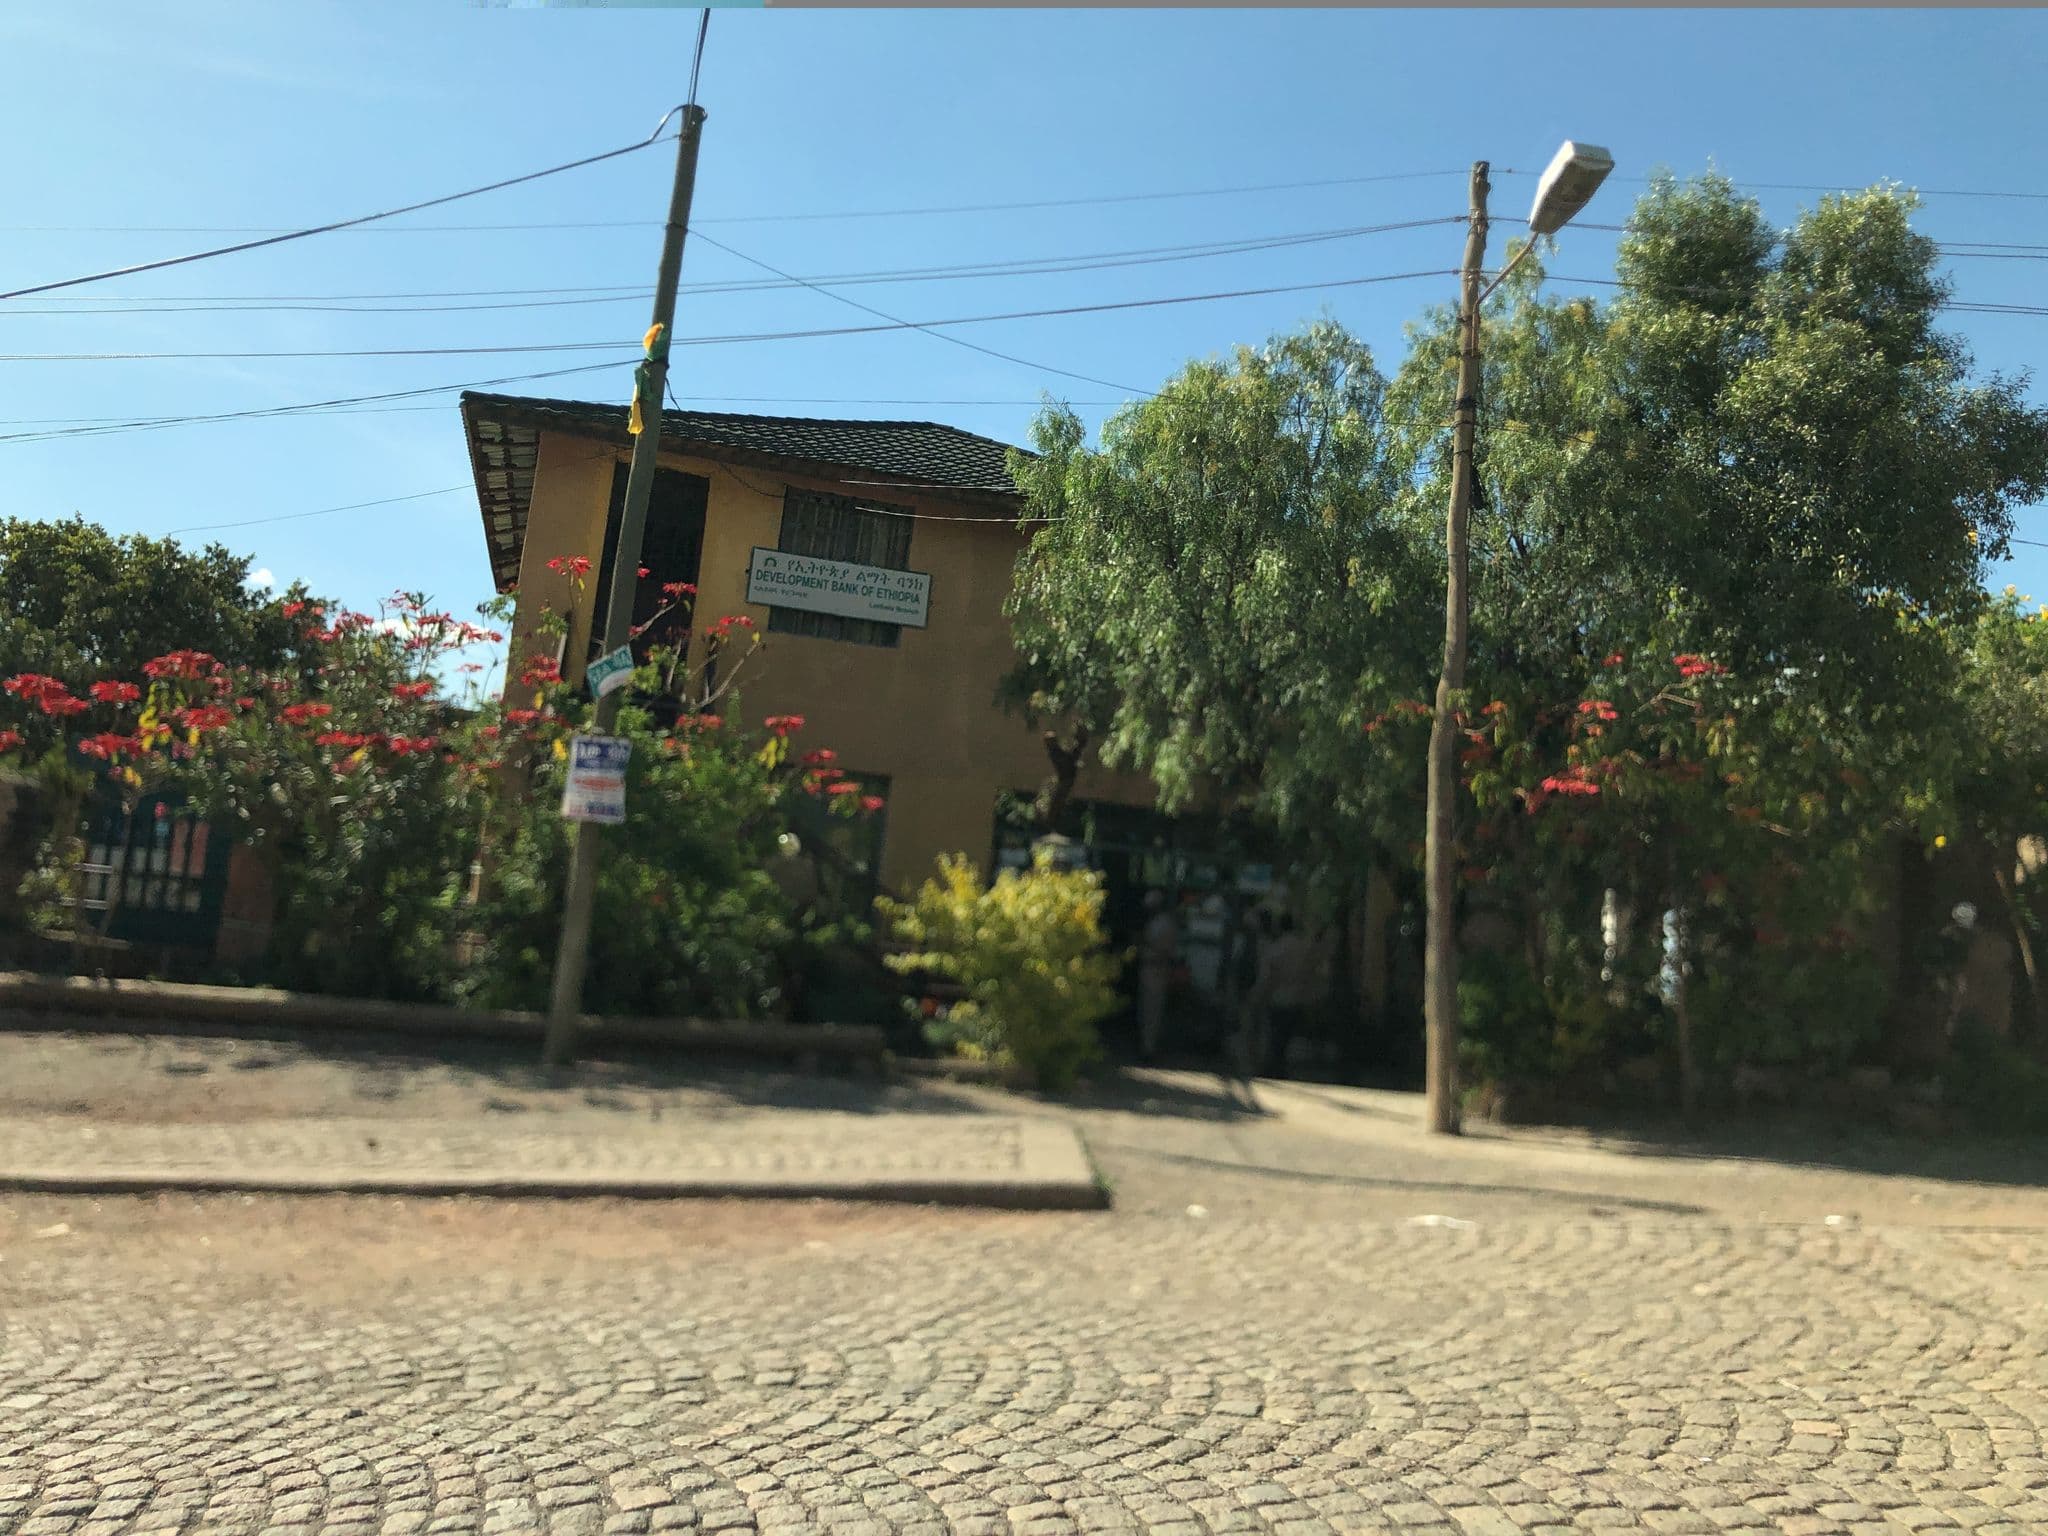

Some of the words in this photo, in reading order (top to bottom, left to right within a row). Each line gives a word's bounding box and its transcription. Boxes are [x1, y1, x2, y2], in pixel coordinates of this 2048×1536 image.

[755, 569, 829, 591] DEVELOPMENT
[831, 580, 859, 595] BANK
[861, 585, 875, 597] OF
[876, 588, 921, 605] ETHIOPIA
[787, 559, 850, 580] የኢትዮጵያ
[856, 570, 891, 585] ልማት
[897, 576, 924, 591] ባንክ
